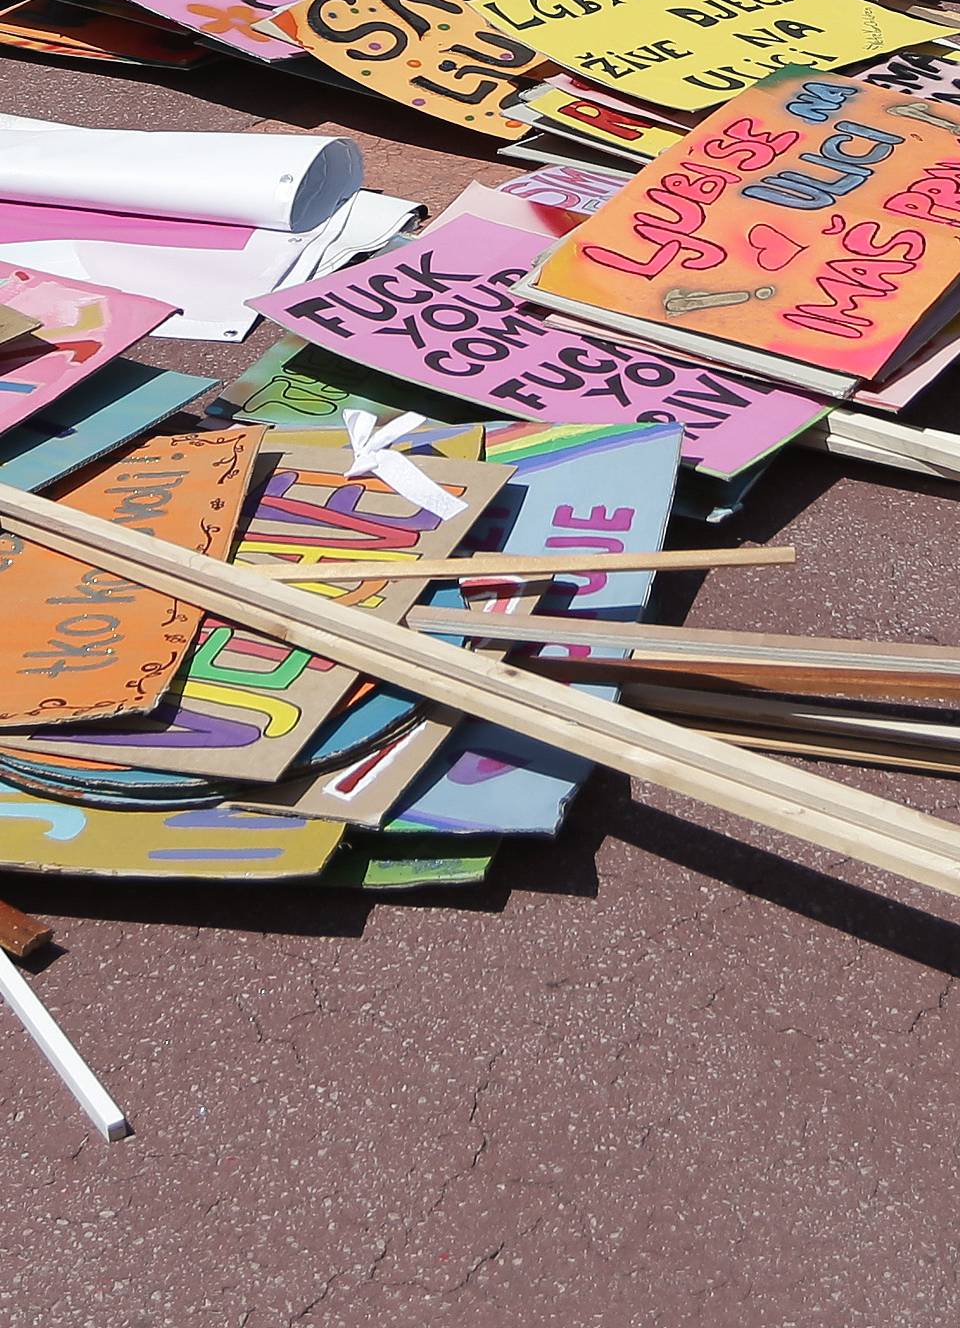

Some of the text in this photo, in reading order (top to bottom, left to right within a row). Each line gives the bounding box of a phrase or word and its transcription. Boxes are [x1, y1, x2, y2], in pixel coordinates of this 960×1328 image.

[732, 19, 827, 48] NA
[581, 161, 742, 280] LJUBI
[704, 117, 799, 171] SE
[785, 81, 858, 122] NA
[739, 120, 905, 211] ULICI
[284, 250, 484, 339] FUCK
[779, 213, 926, 340] IMAŠ
